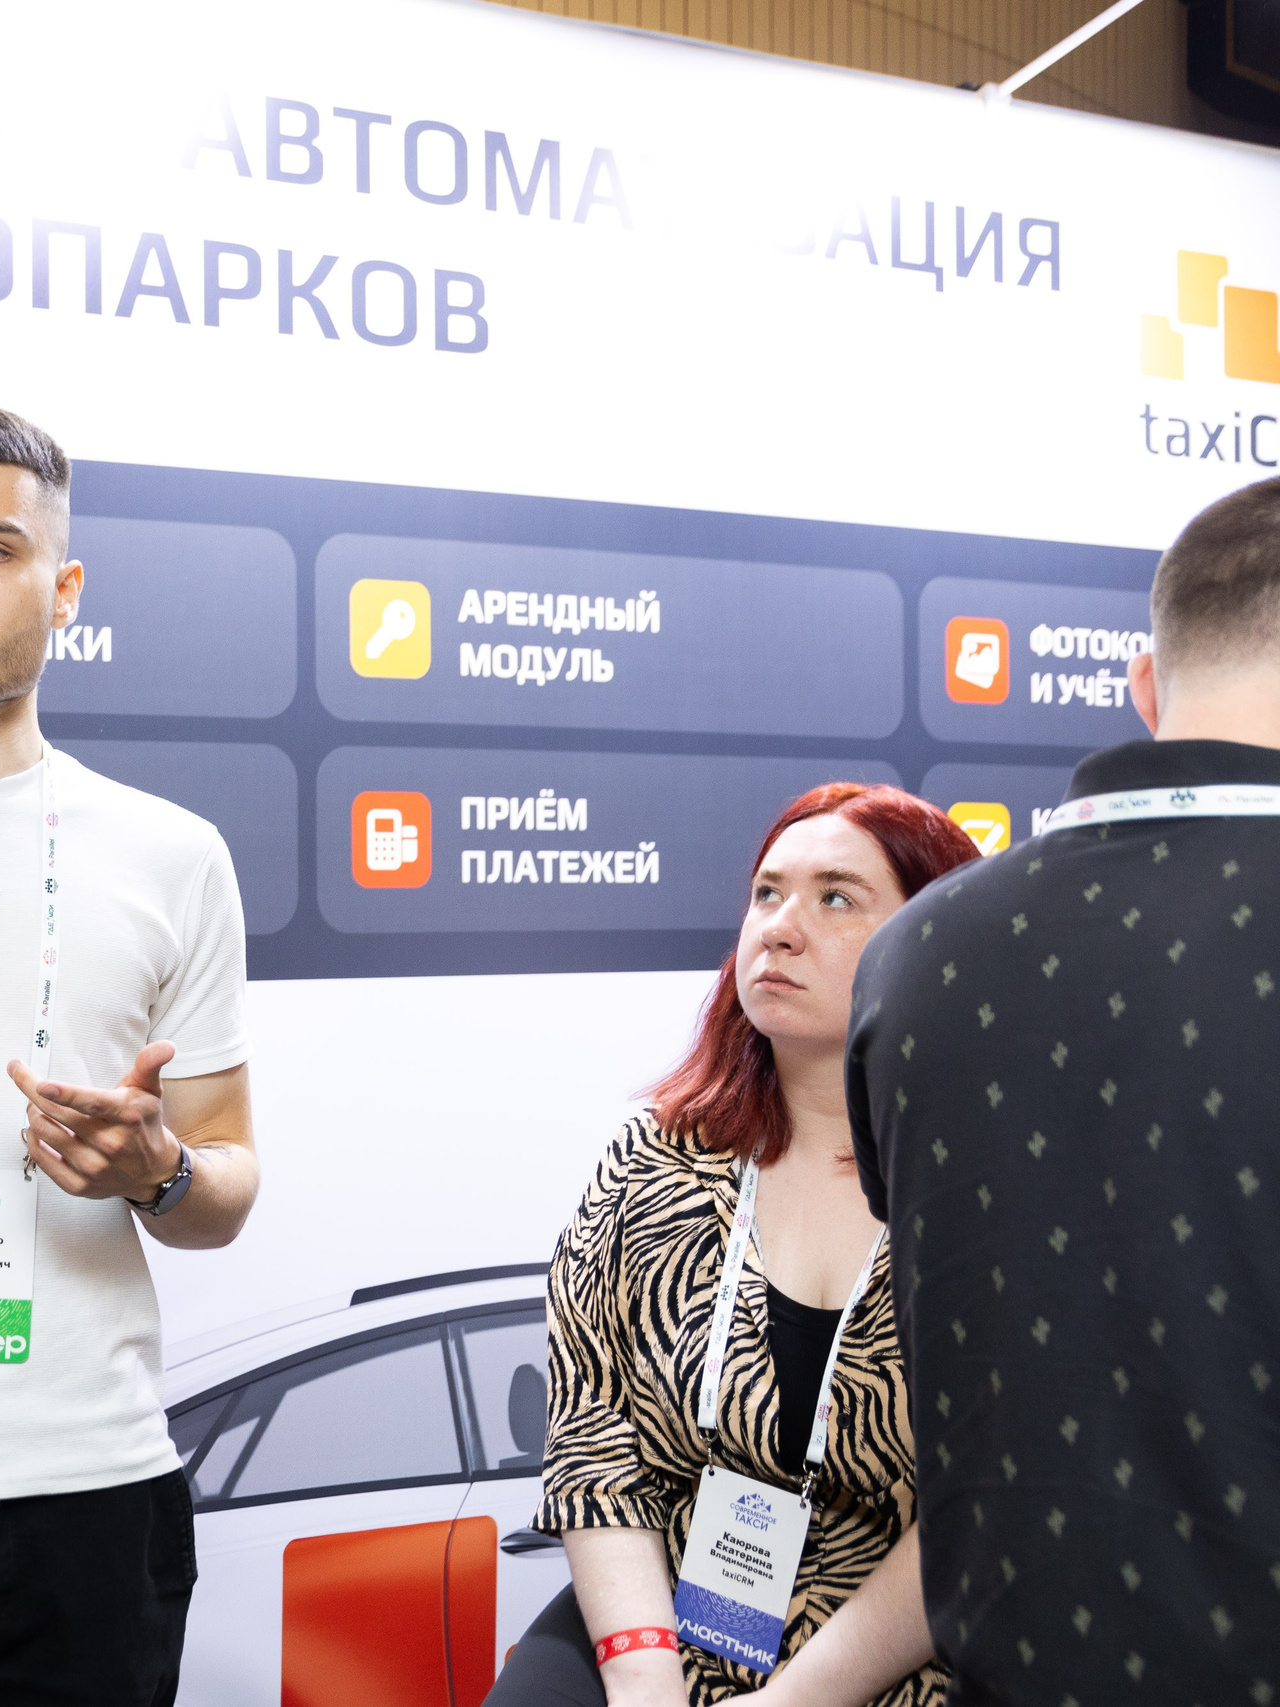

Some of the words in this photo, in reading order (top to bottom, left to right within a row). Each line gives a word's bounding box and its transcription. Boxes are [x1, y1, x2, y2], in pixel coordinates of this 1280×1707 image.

[180, 90, 1063, 292] АВТОМААЦИЯ
[458, 589, 660, 635] АРЕНДНЫЙ
[1029, 623, 1155, 662] ФОТОКО
[459, 642, 614, 687] МОДУЛЬ
[1030, 672, 1053, 704] И
[1056, 668, 1128, 708] УЧЁТ
[461, 788, 588, 831] ПРИЁМ
[461, 841, 660, 884] ПЛАТЕЖЕЙ
[43, 980, 51, 1005] Parallel
[730, 1502, 777, 1525] СОВРЕМЕННОЕ
[734, 1511, 769, 1532] ТАКСИ
[716, 1540, 773, 1570] Екатерина
[723, 1531, 771, 1558] Каюрова
[710, 1548, 774, 1580] Владимировна
[722, 1568, 755, 1588] taxiCRM
